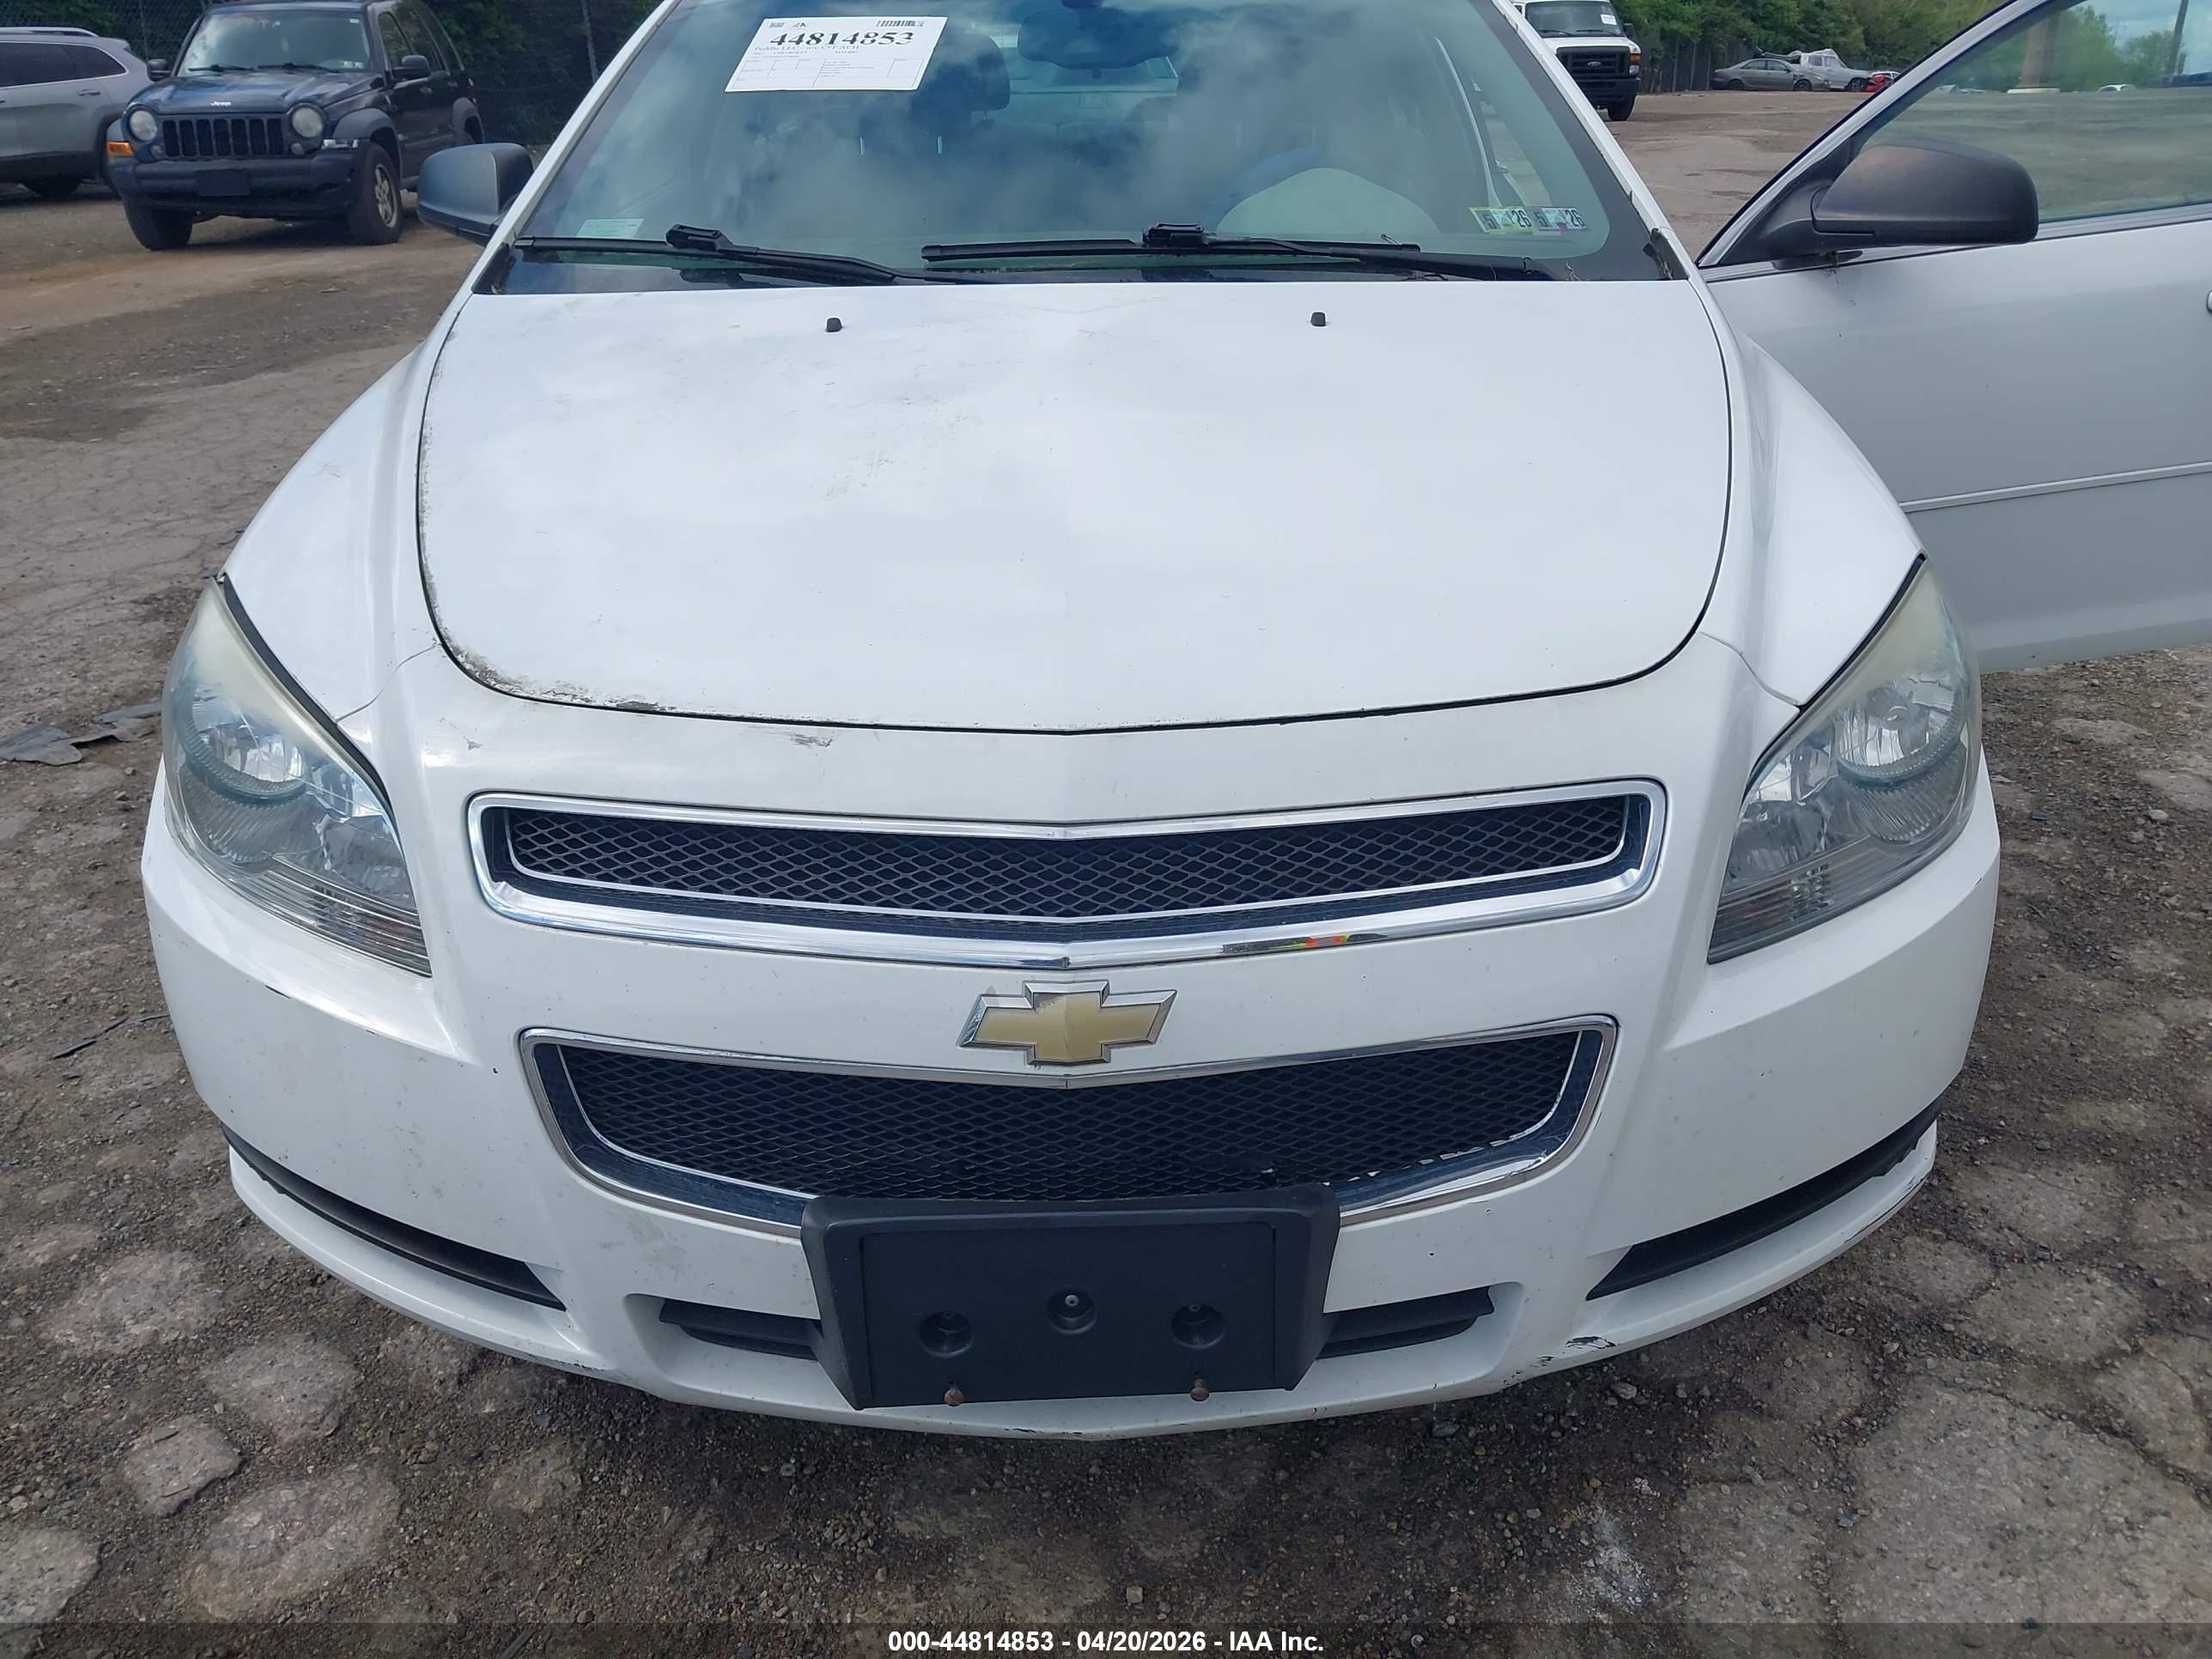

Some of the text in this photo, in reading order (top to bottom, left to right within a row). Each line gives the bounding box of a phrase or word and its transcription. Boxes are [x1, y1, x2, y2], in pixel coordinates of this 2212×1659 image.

[769, 32, 914, 46] 44814853
[1483, 210, 1533, 229] 5 26
[1534, 210, 1586, 228] 5 26
